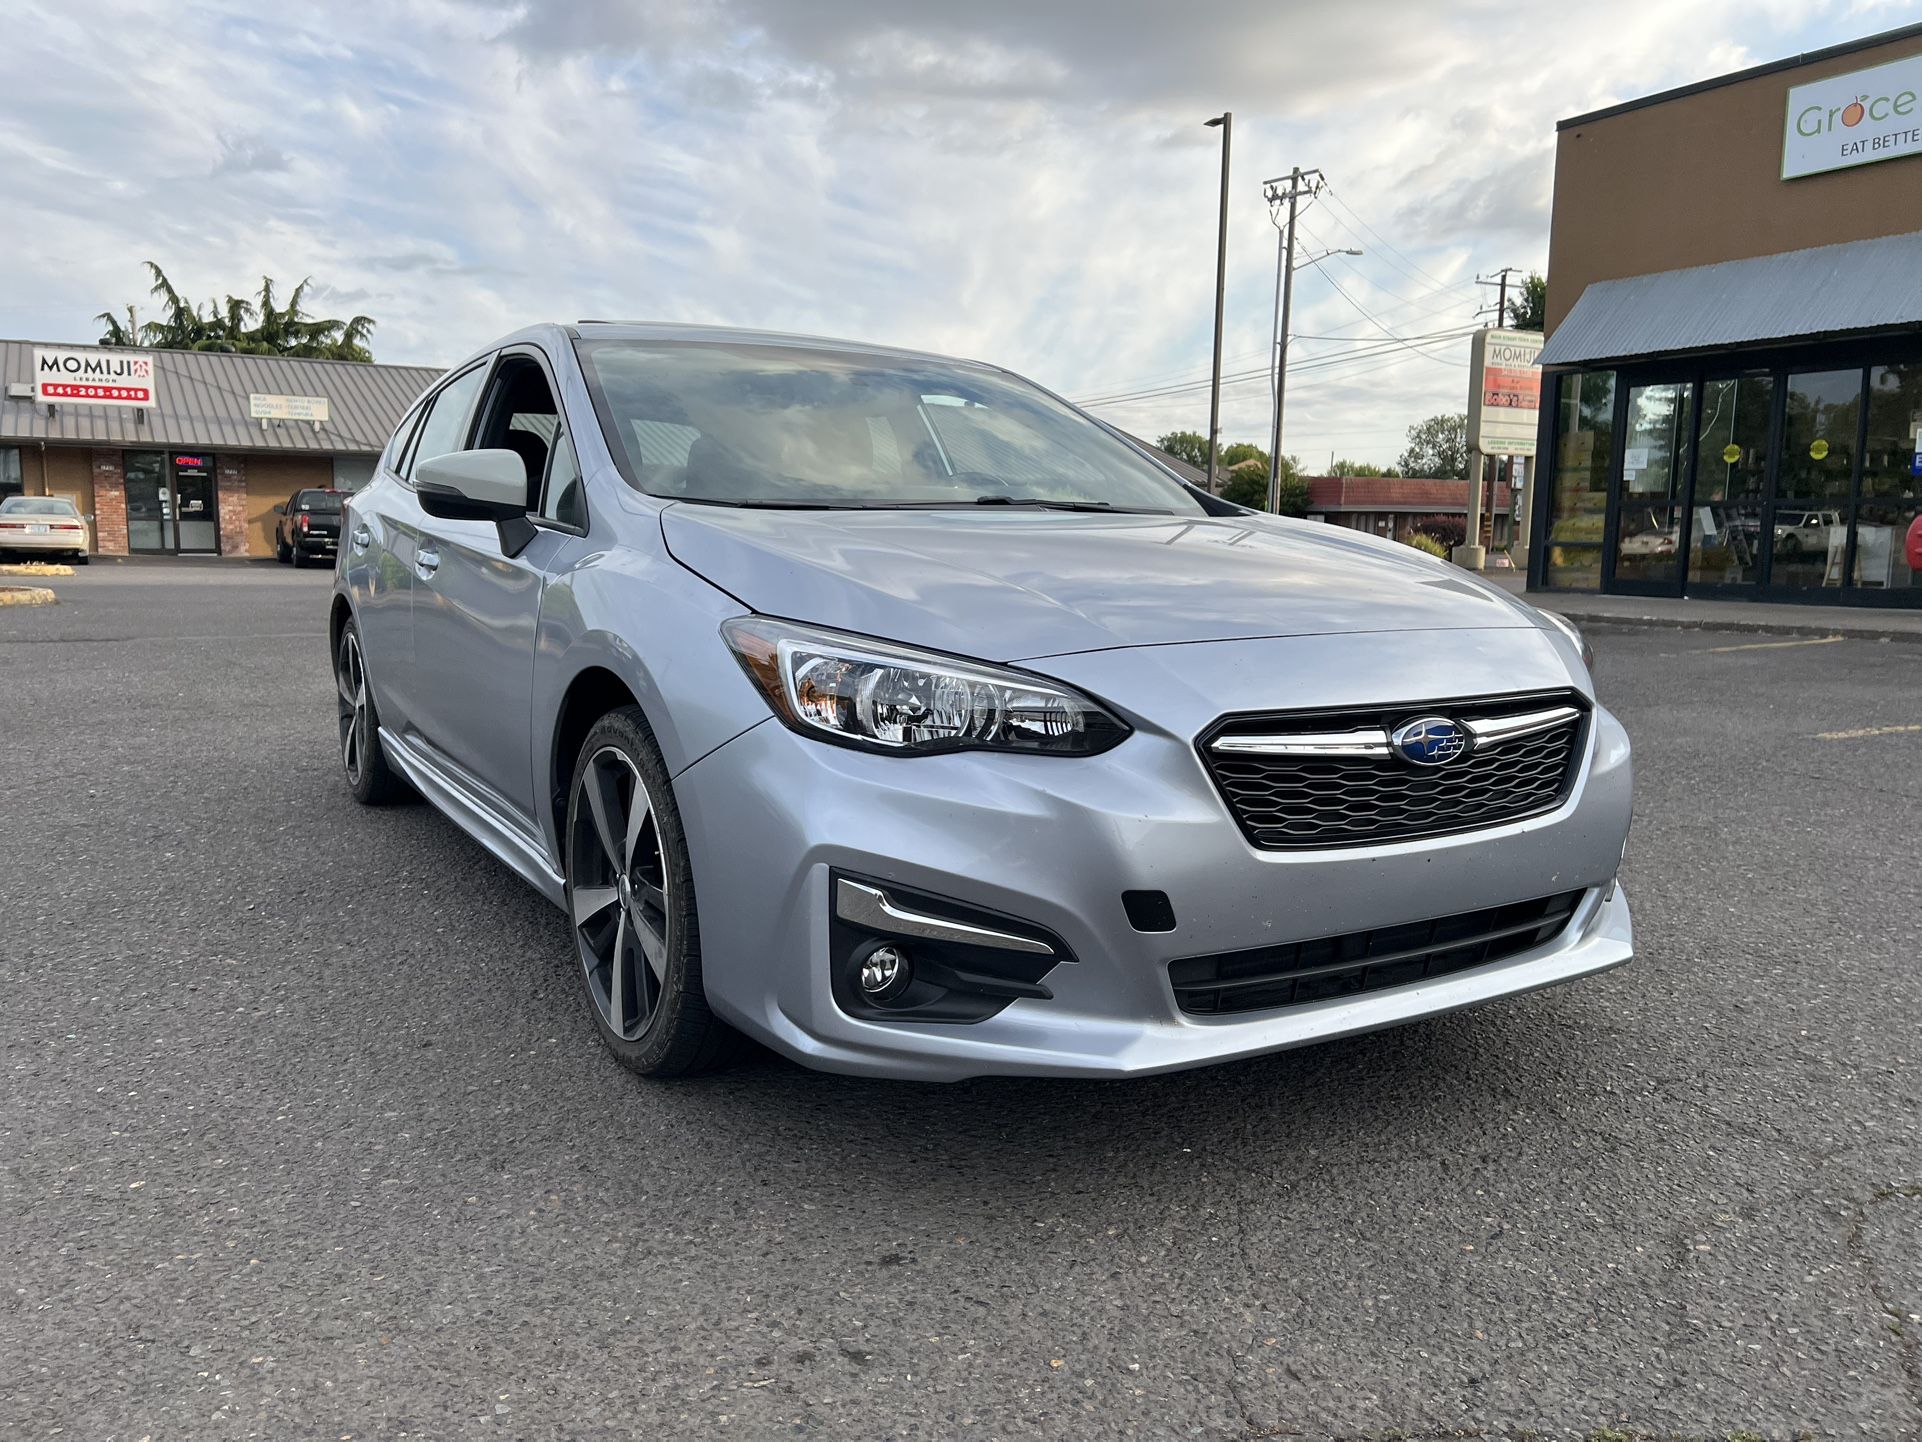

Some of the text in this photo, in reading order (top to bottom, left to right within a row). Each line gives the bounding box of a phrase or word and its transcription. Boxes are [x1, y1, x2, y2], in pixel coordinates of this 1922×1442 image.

[1840, 128, 1921, 157] EAT BETTE
[40, 355, 131, 377] MOMIJI
[73, 376, 117, 384] LEBANON
[46, 385, 145, 399] 541-205-9918
[175, 456, 203, 467] OPEN
